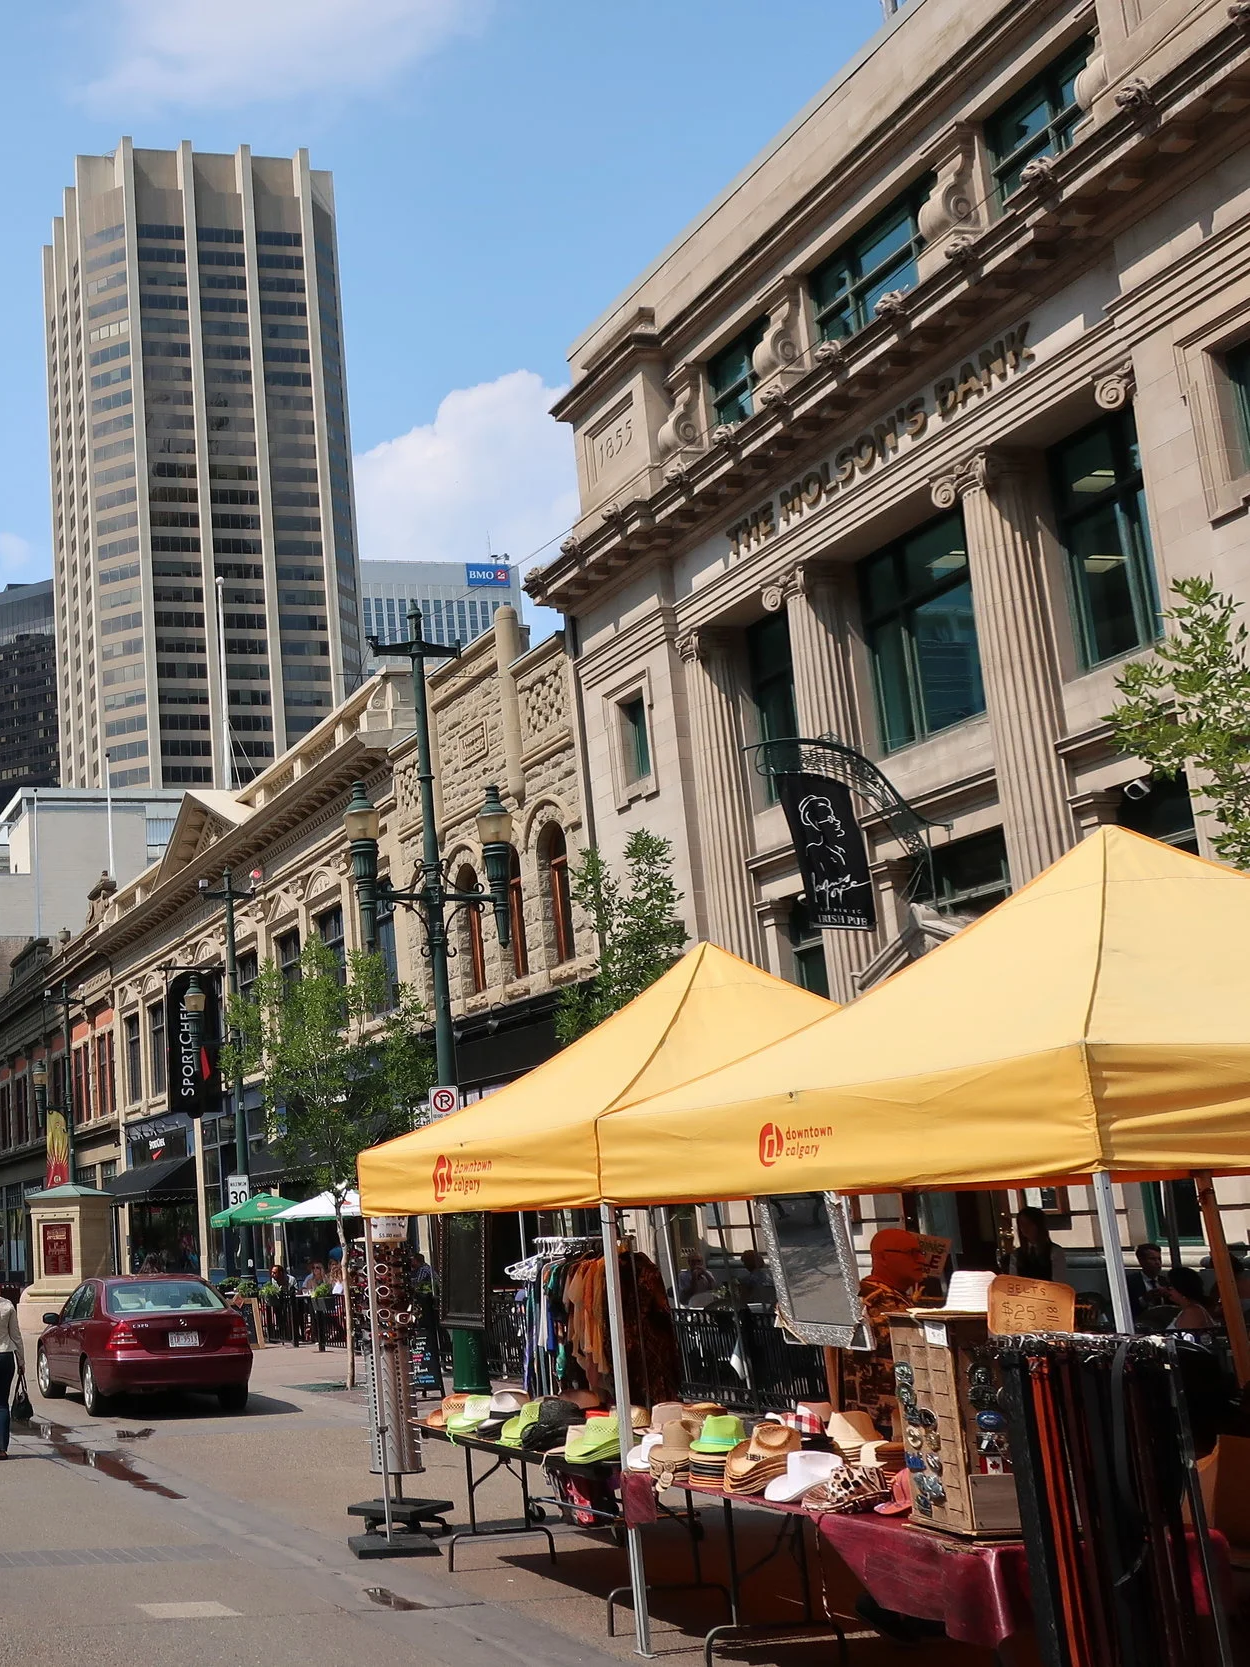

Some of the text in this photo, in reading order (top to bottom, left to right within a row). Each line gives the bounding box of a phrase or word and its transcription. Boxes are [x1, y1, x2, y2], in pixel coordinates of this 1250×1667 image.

[599, 418, 632, 468] 1855
[726, 321, 1036, 556] THE MOLSON'S BANK
[469, 570, 494, 579] BMO
[818, 914, 868, 926] IRISH PUB
[786, 1126, 833, 1140] downtown
[785, 1142, 819, 1159] calgary
[454, 1160, 492, 1174] downtown
[453, 1177, 481, 1195] calgary
[230, 1190, 248, 1205] 30
[1007, 1283, 1047, 1296] BELTS
